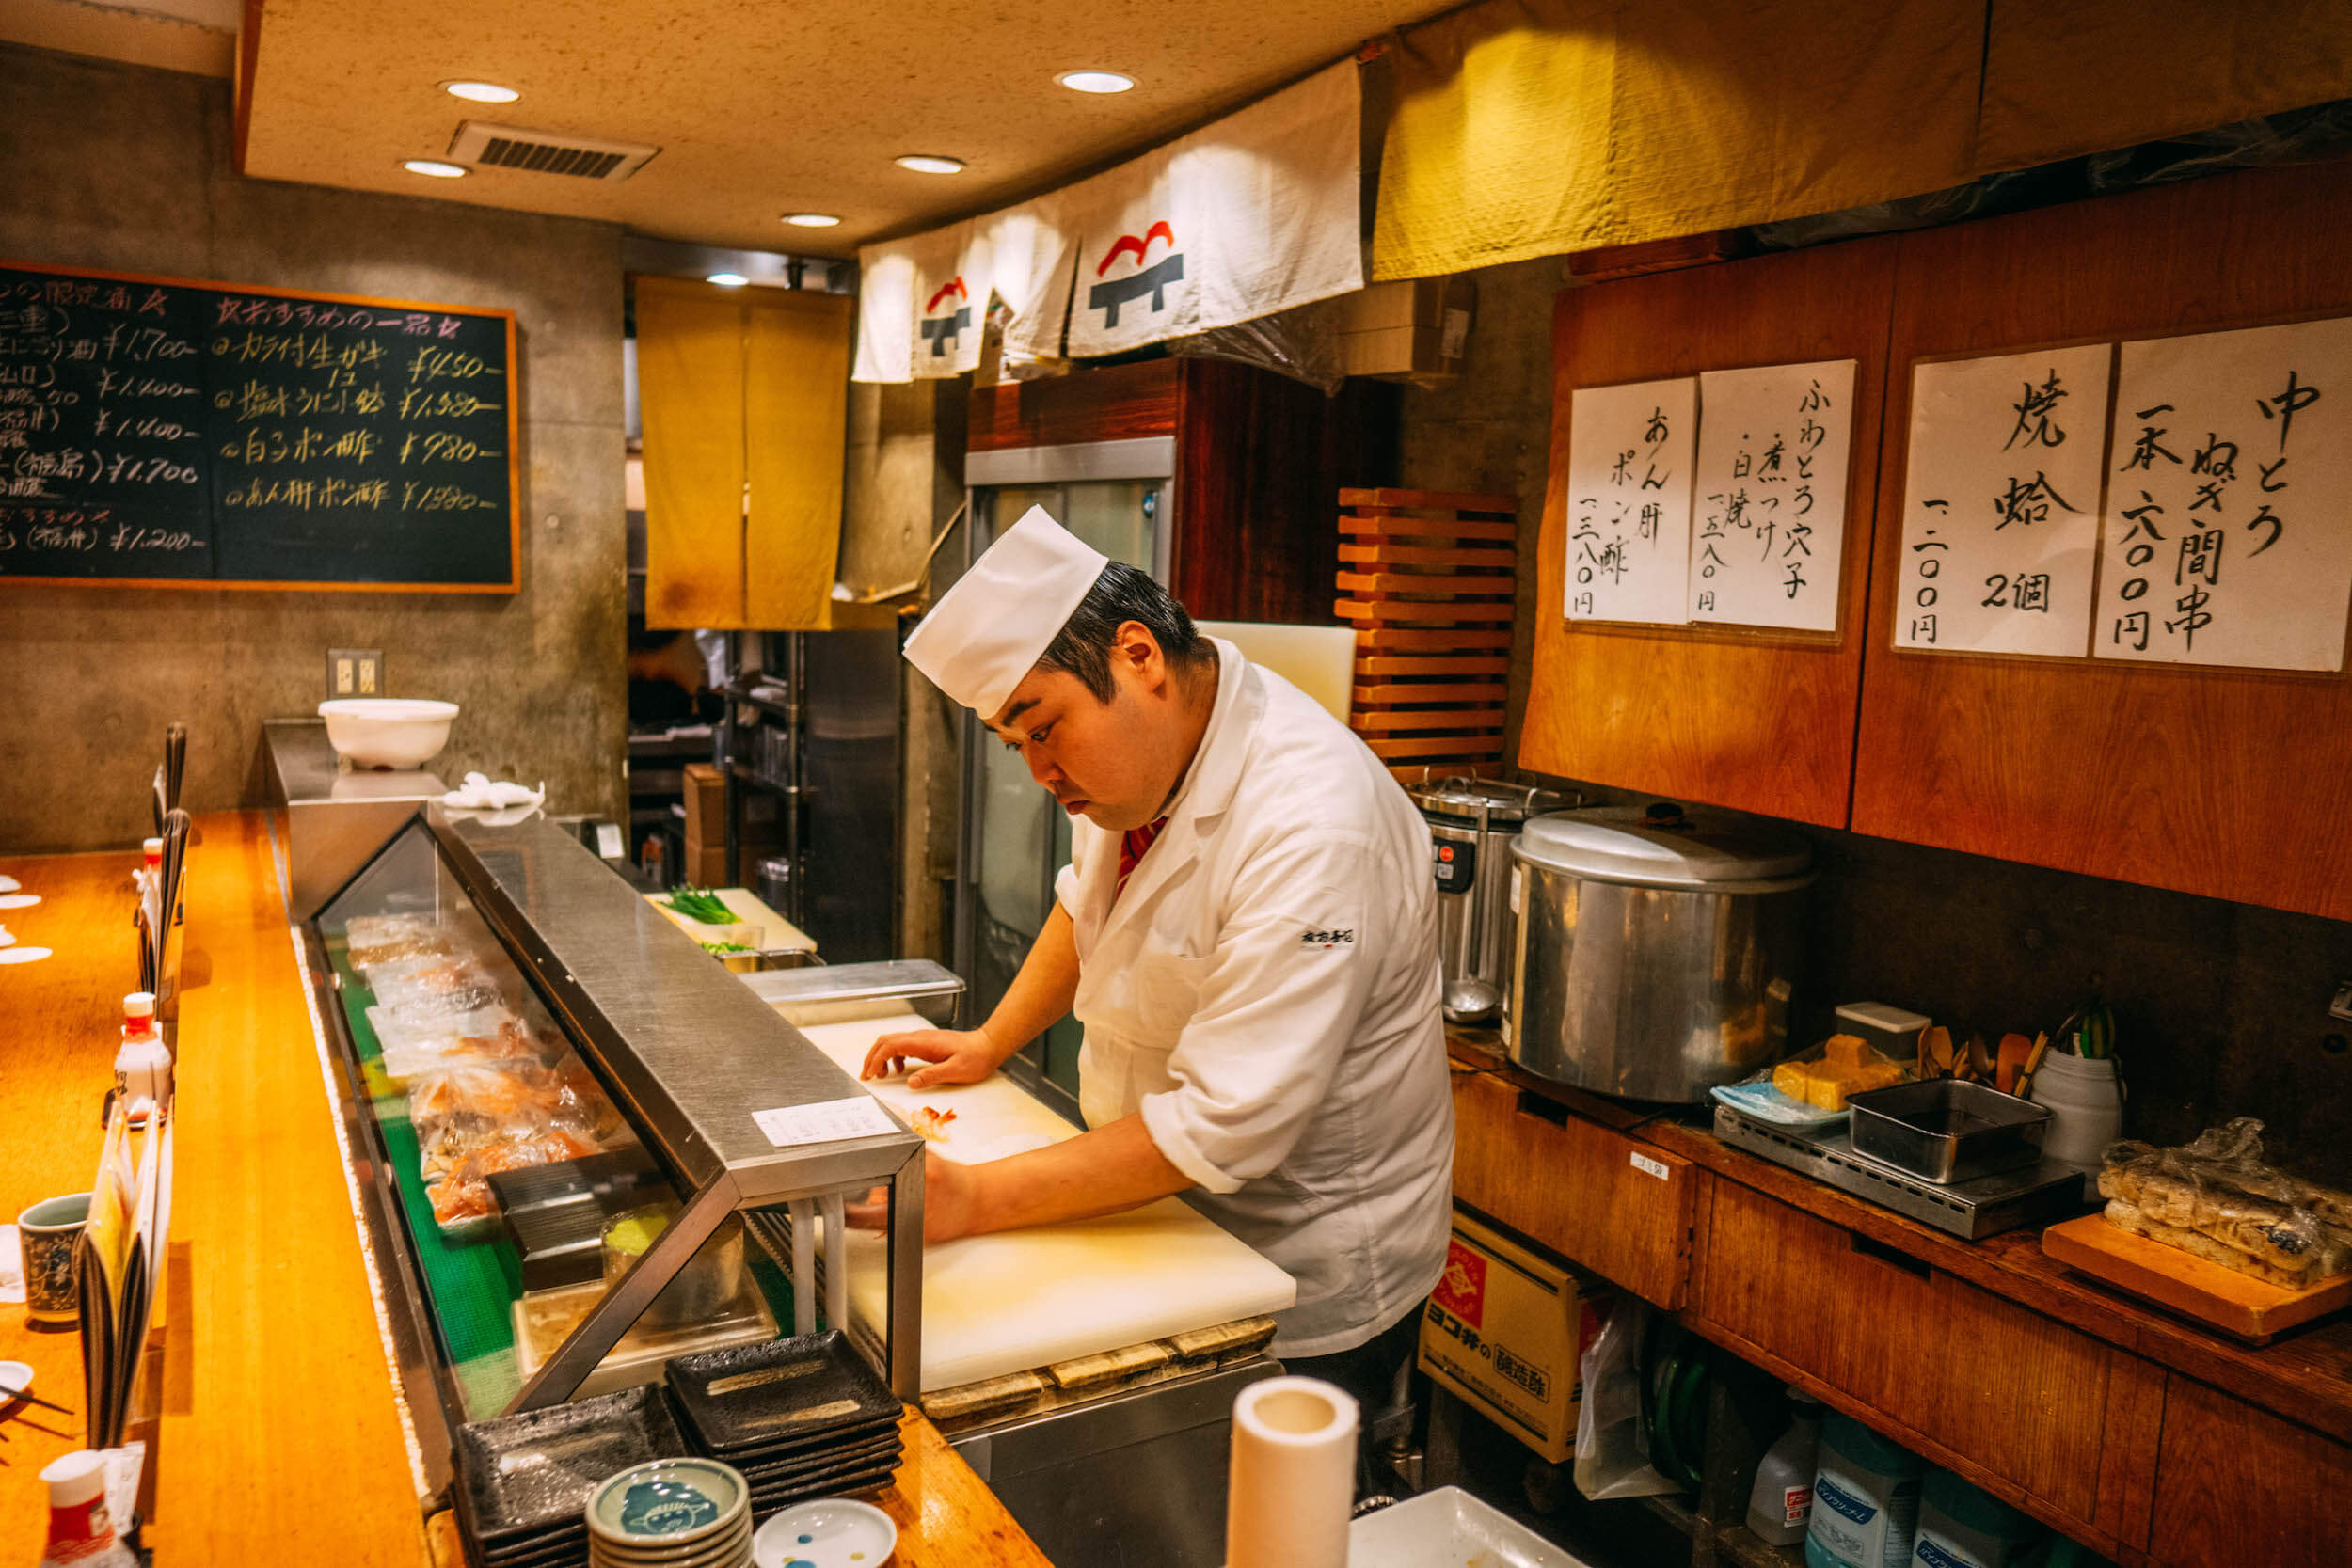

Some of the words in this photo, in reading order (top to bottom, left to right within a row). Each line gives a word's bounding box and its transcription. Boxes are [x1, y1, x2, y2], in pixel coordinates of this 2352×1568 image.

[1641, 406, 1672, 550] あん肝
[1783, 378, 1831, 599] ふわとろ穴子
[2246, 370, 2321, 559] 中とろ
